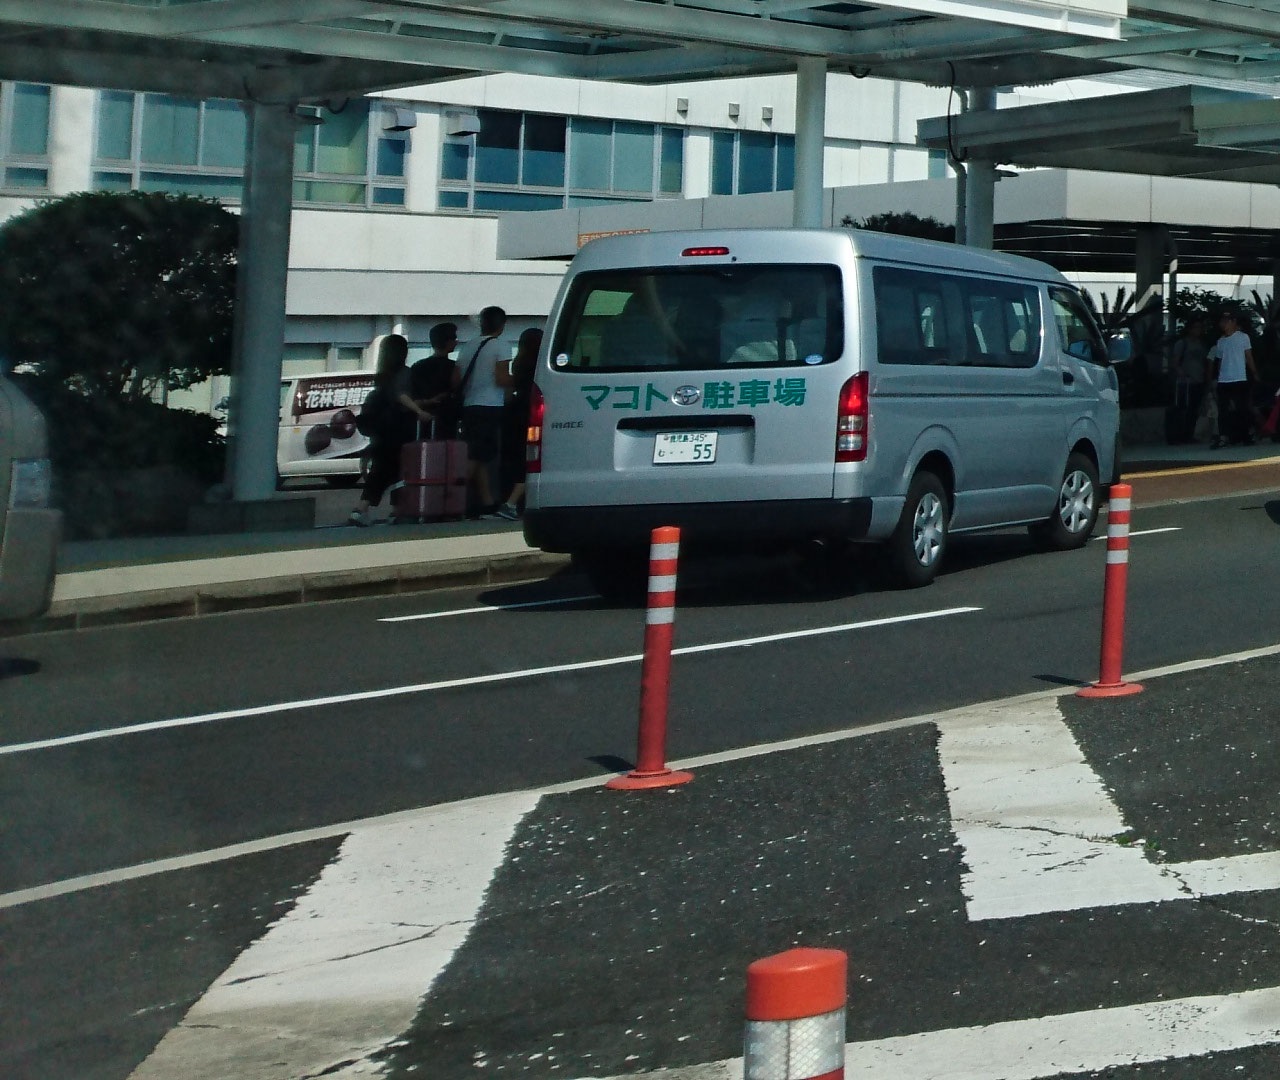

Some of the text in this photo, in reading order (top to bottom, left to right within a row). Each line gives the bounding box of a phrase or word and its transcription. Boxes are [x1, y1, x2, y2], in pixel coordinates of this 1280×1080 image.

[580, 377, 808, 411] マコト 駐車場
